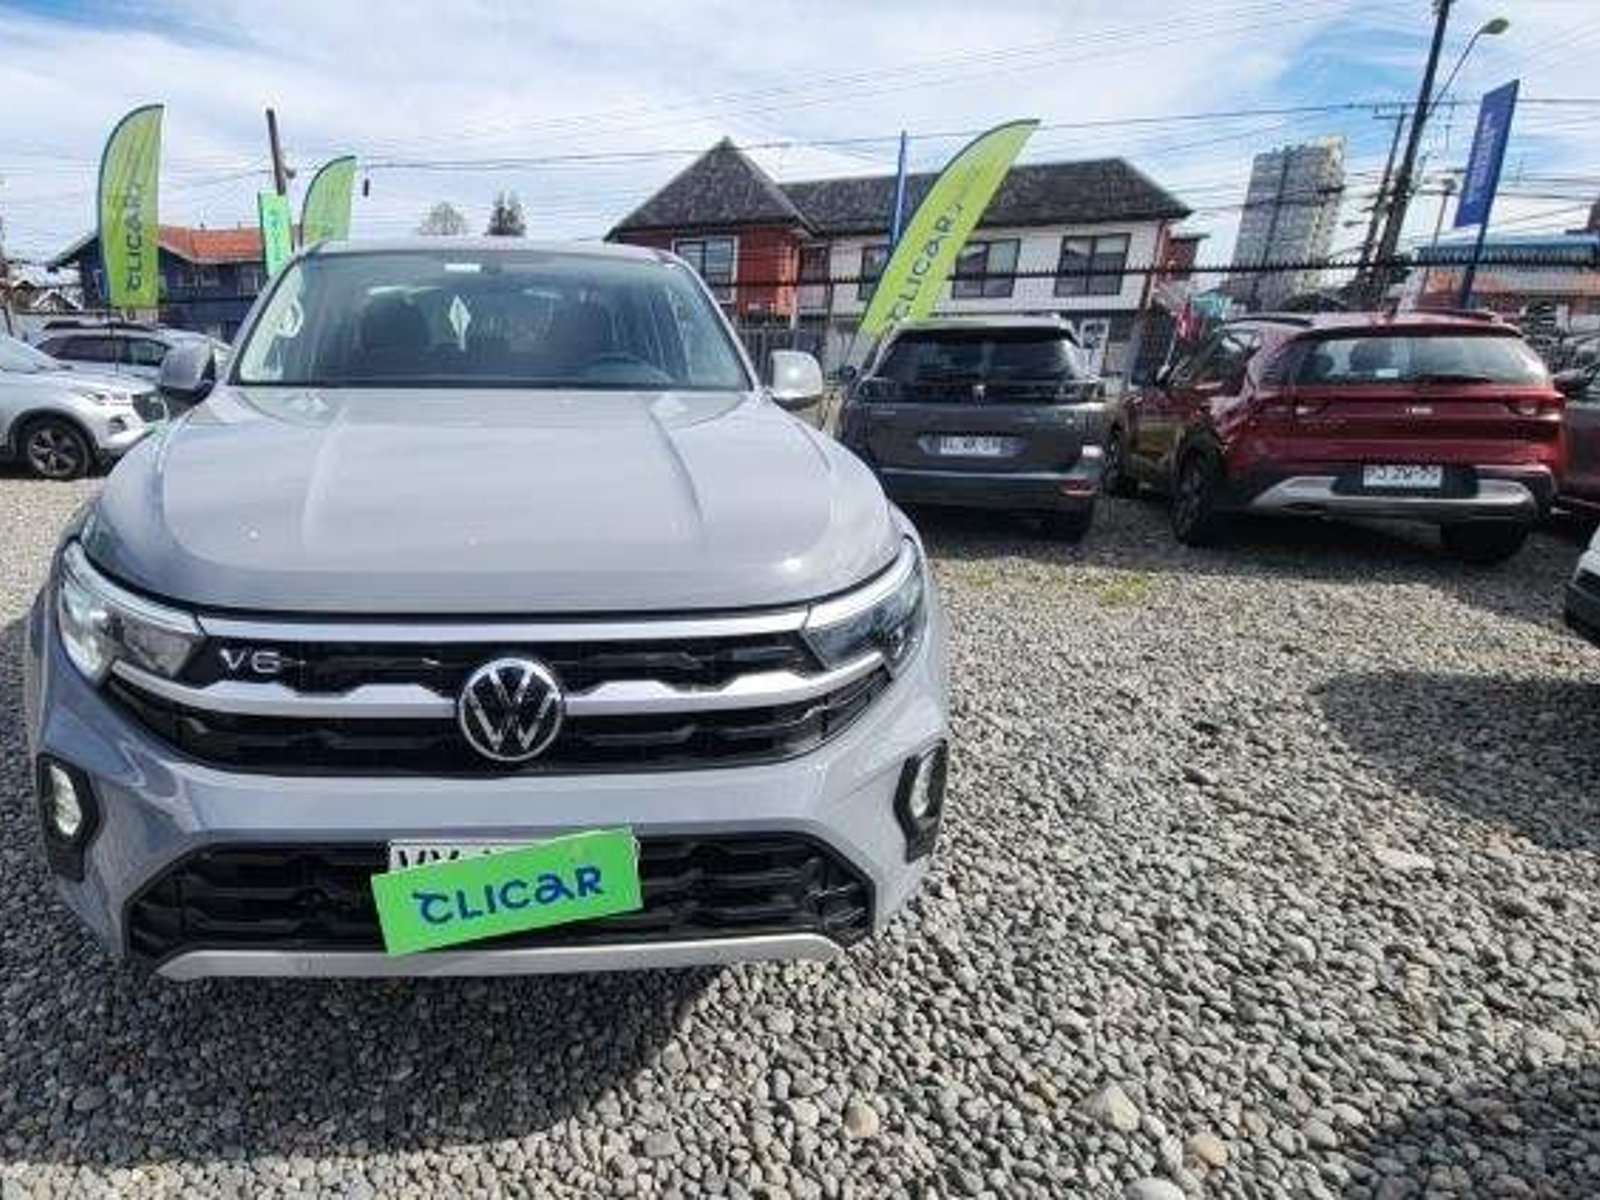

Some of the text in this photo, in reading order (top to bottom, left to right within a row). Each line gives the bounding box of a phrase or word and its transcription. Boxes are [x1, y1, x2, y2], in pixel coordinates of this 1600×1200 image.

[219, 648, 281, 676] V6
[459, 658, 563, 761] VW
[411, 865, 604, 926] CLICaR
